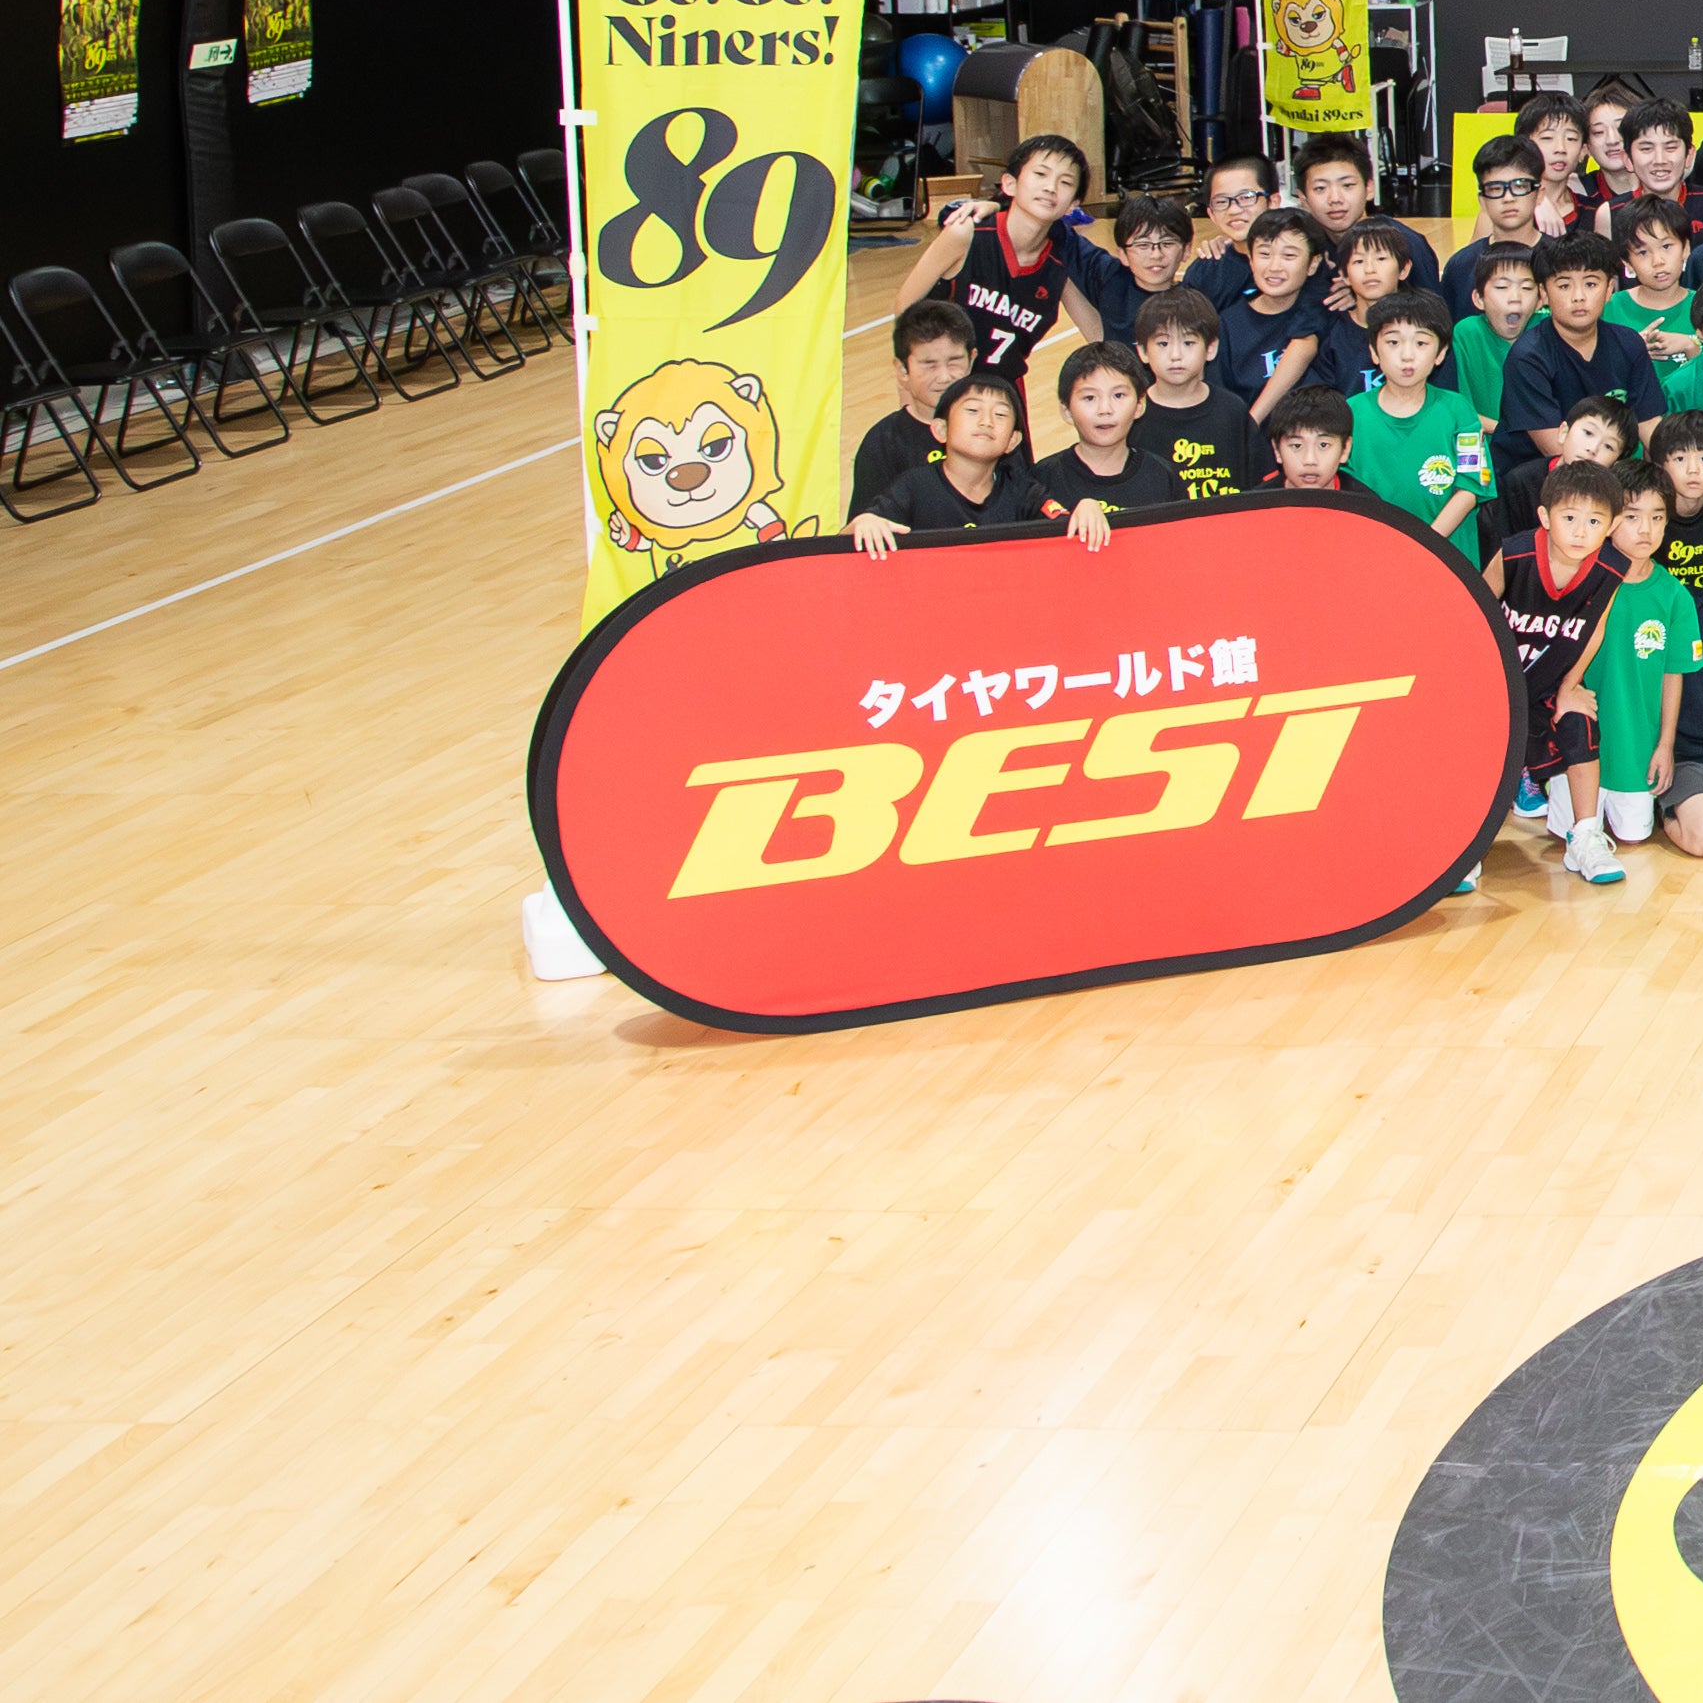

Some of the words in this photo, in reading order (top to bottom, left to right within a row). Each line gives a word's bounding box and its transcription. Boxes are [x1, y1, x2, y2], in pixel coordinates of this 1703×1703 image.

[604, 15, 839, 67] Niners!
[599, 107, 836, 333] 89
[987, 328, 1015, 365] 7
[859, 636, 1258, 729] タイヤワールド館
[667, 675, 1416, 898] BEST
